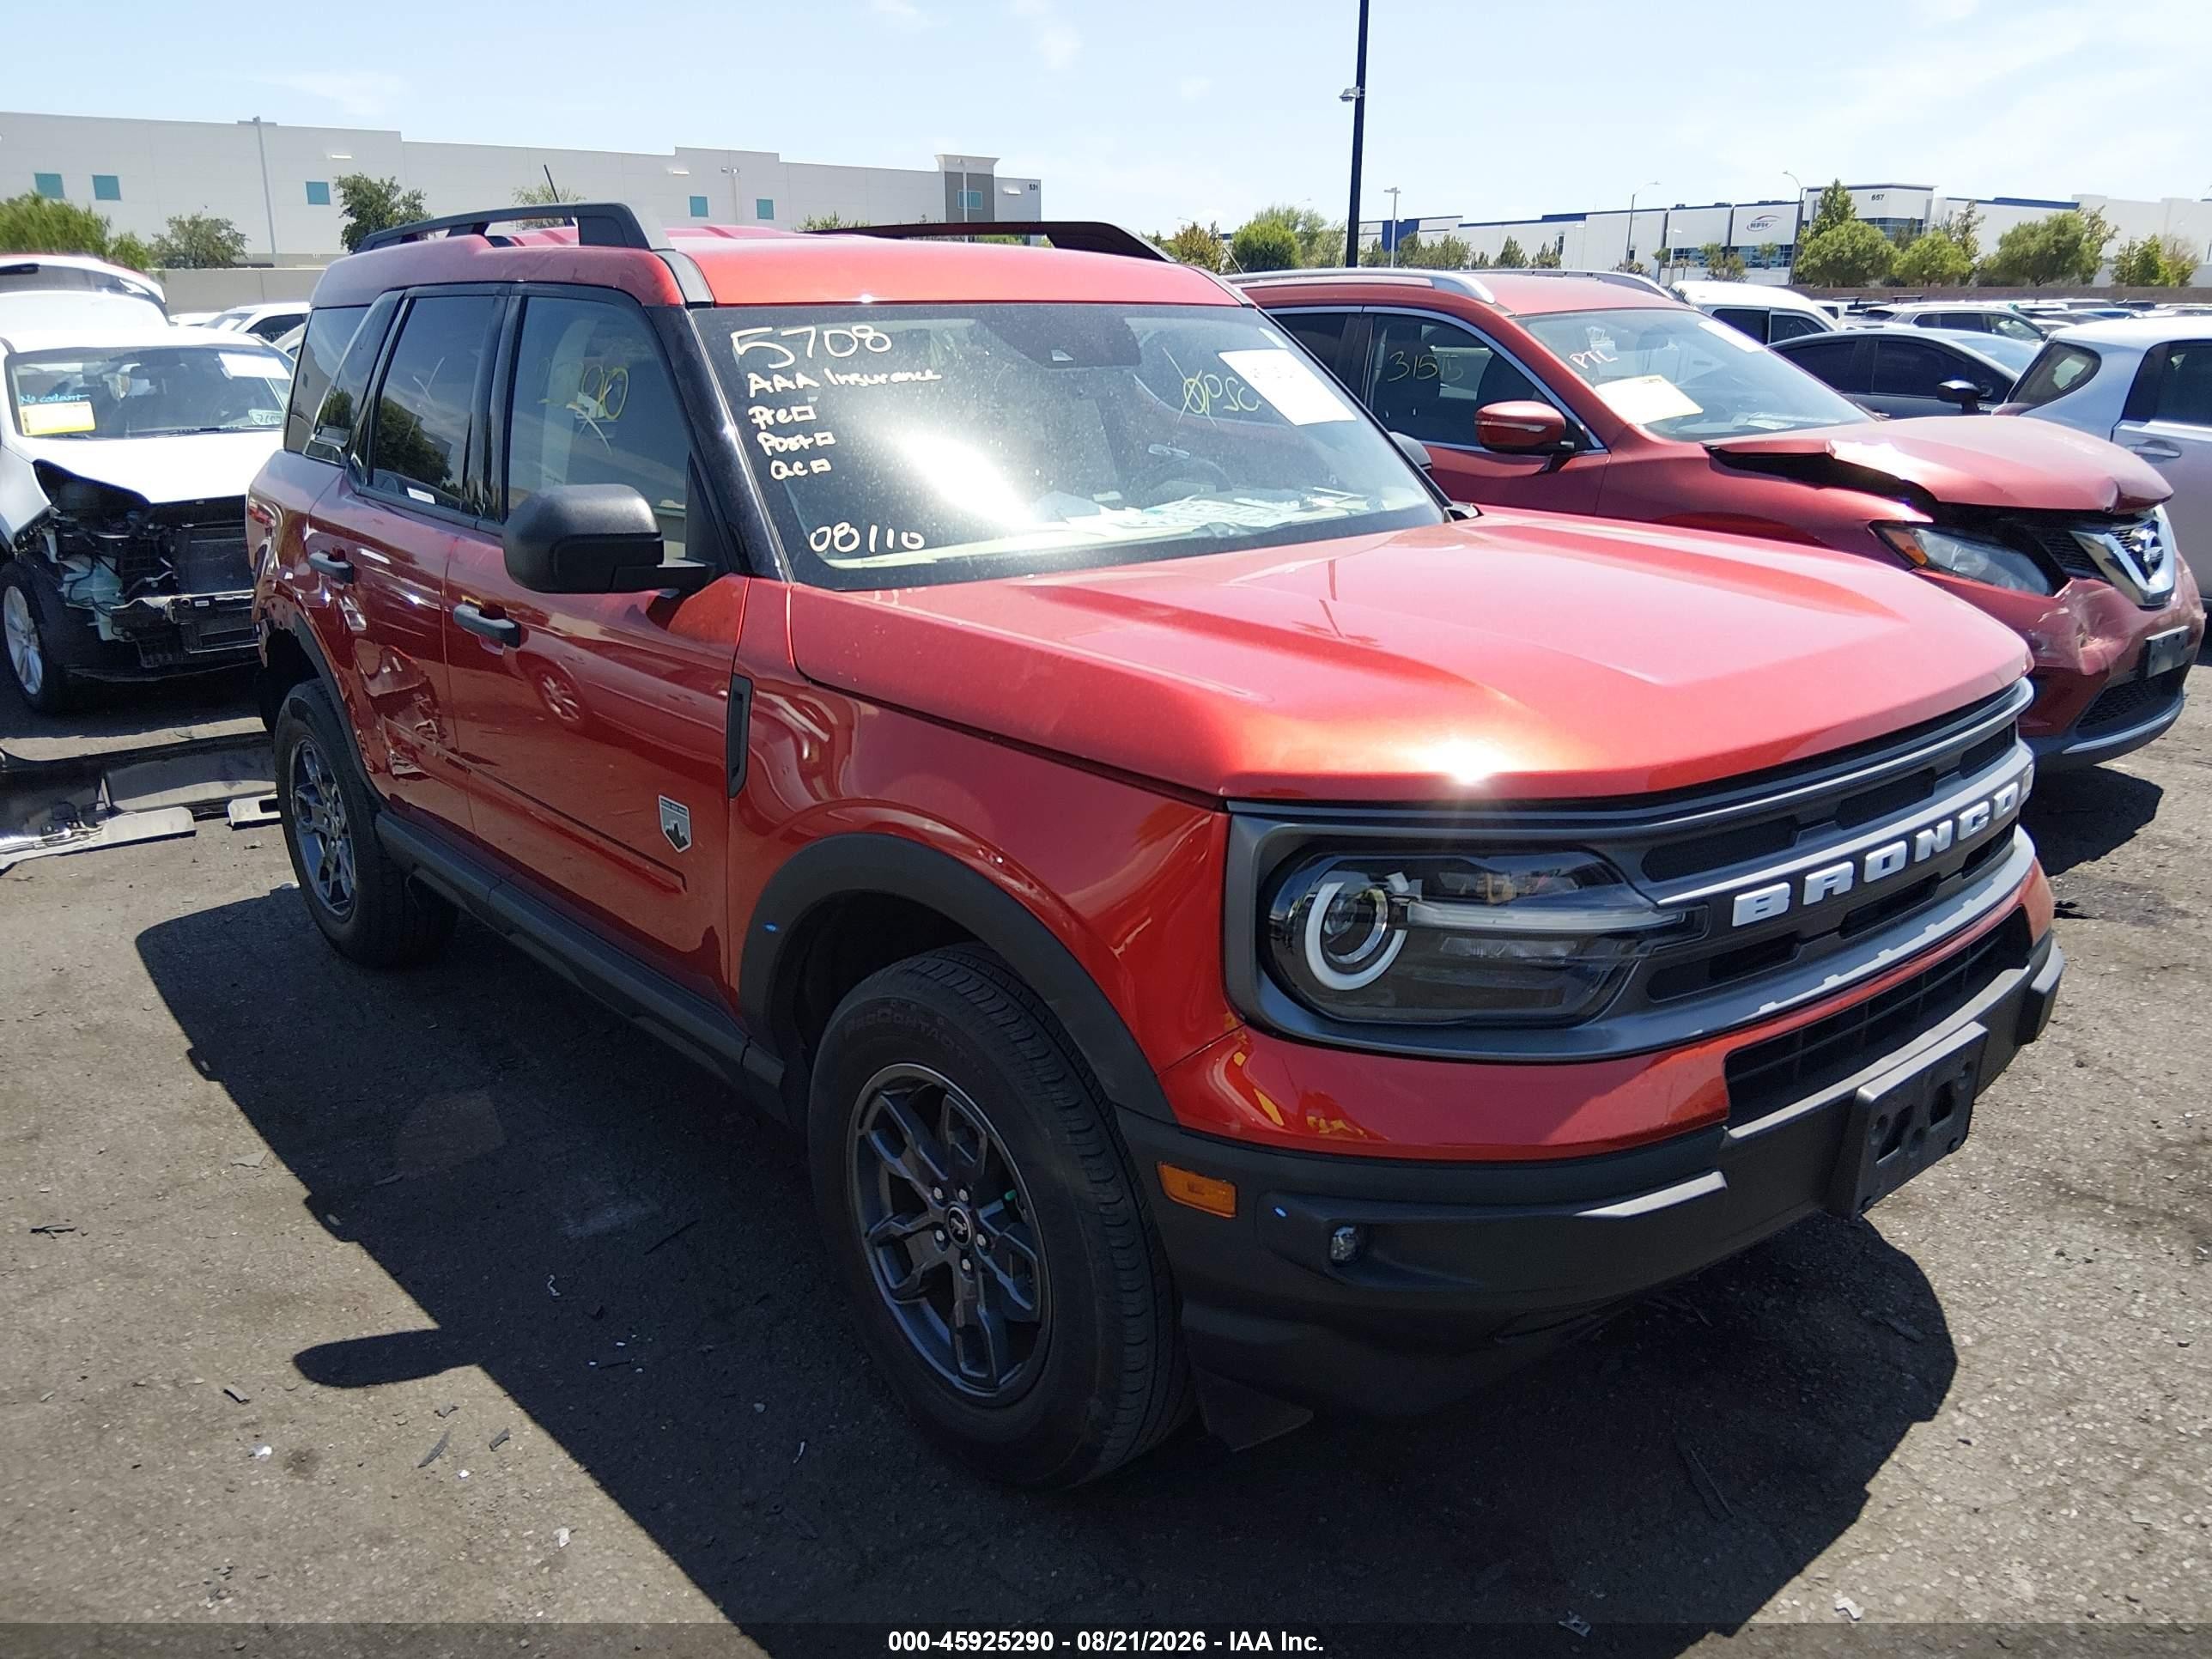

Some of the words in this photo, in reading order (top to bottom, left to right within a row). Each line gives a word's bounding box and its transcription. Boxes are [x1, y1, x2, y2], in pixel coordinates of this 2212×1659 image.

[731, 325, 892, 368] 5708
[1569, 348, 1619, 369] PTL
[747, 373, 820, 398] AAA
[823, 368, 942, 387] Insurance
[1732, 781, 2020, 927] BRONCO
